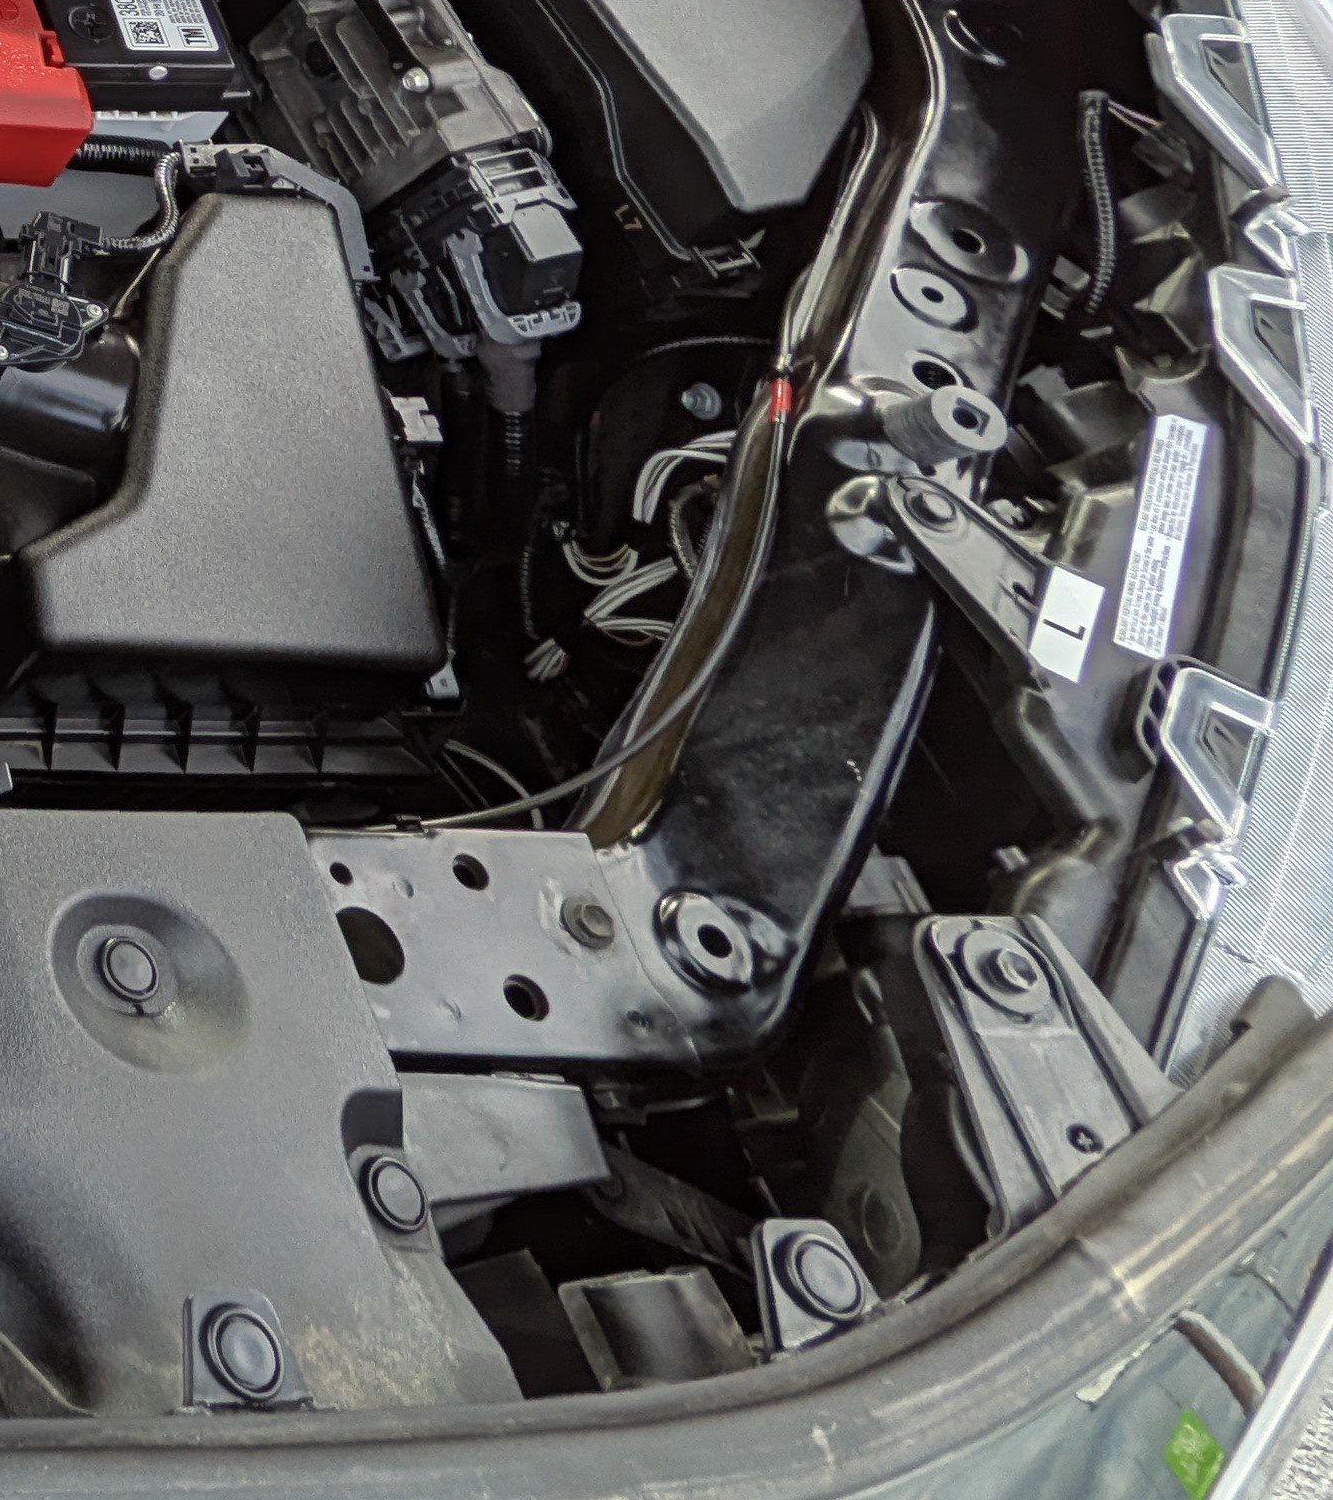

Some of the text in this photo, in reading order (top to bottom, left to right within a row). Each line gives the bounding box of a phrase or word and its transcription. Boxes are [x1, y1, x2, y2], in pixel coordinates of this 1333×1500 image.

[182, 28, 208, 45] TM
[614, 204, 643, 230] L7
[1042, 618, 1086, 641] L
